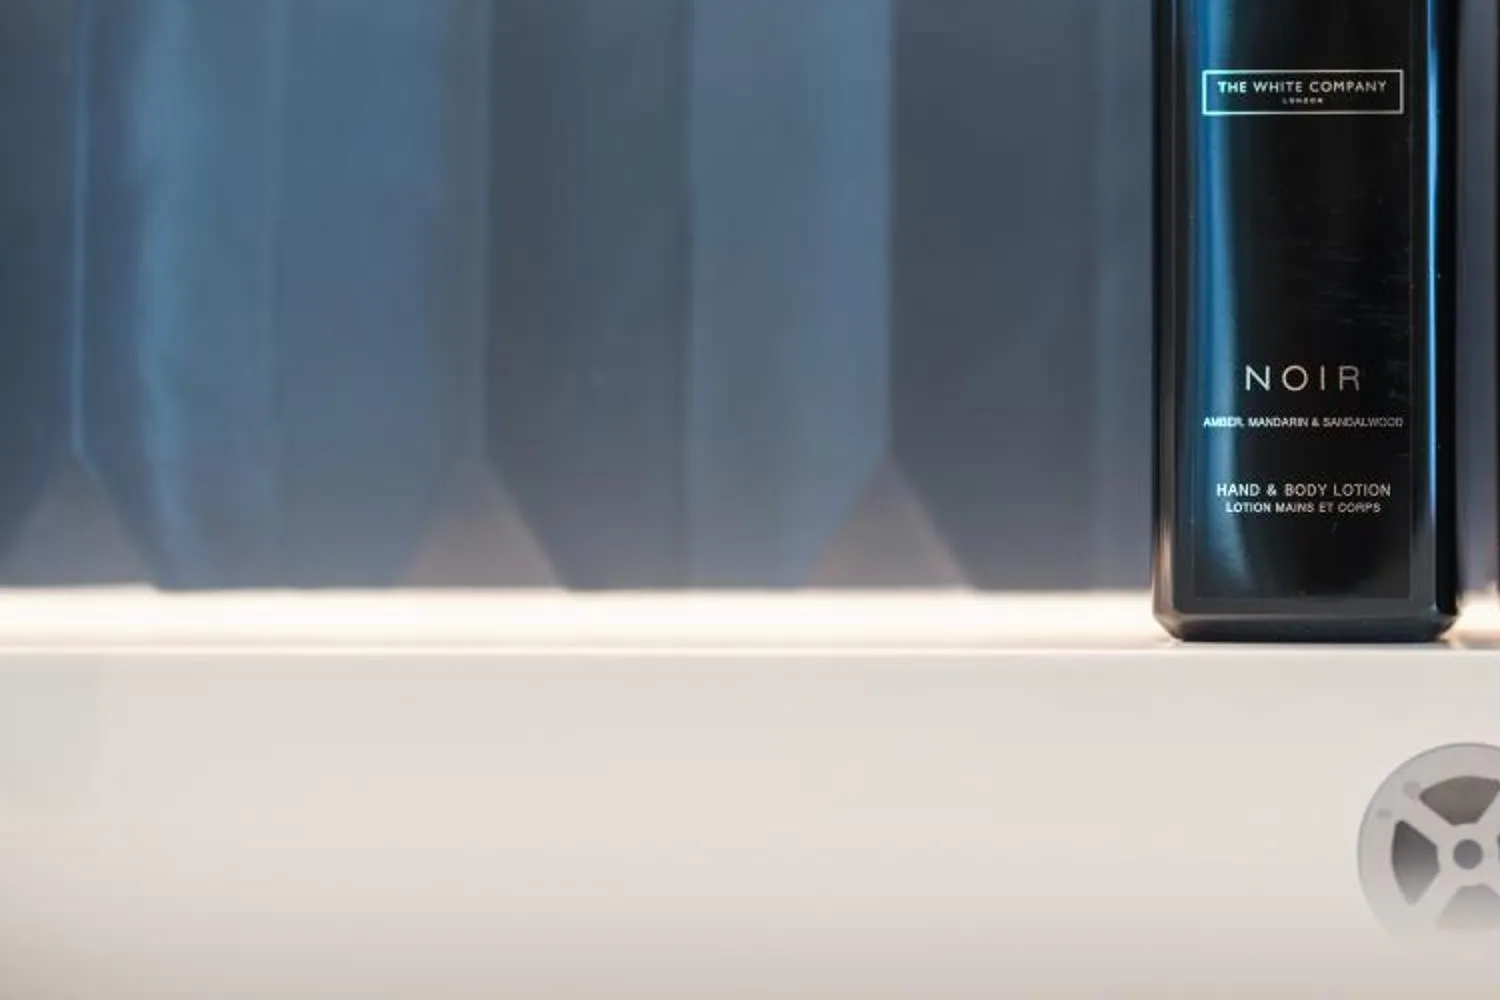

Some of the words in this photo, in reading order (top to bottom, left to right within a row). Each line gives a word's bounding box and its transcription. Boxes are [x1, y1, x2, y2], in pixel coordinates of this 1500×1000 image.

[1217, 80, 1247, 93] THE
[1253, 80, 1303, 93] WHITE
[1309, 80, 1387, 92] COMPANY
[1245, 365, 1360, 391] NOIR
[1248, 417, 1308, 428] MANDARIN
[1312, 417, 1320, 427] &
[1323, 417, 1403, 428] SANDALWOOD
[1216, 484, 1260, 496] HAND
[1267, 484, 1277, 496] &
[1284, 484, 1328, 496] BODY
[1333, 484, 1391, 496] LOTION
[1226, 503, 1271, 513] LOTION
[1275, 503, 1314, 513] MAINS
[1319, 503, 1332, 513] ET
[1338, 503, 1381, 513] CORPS
